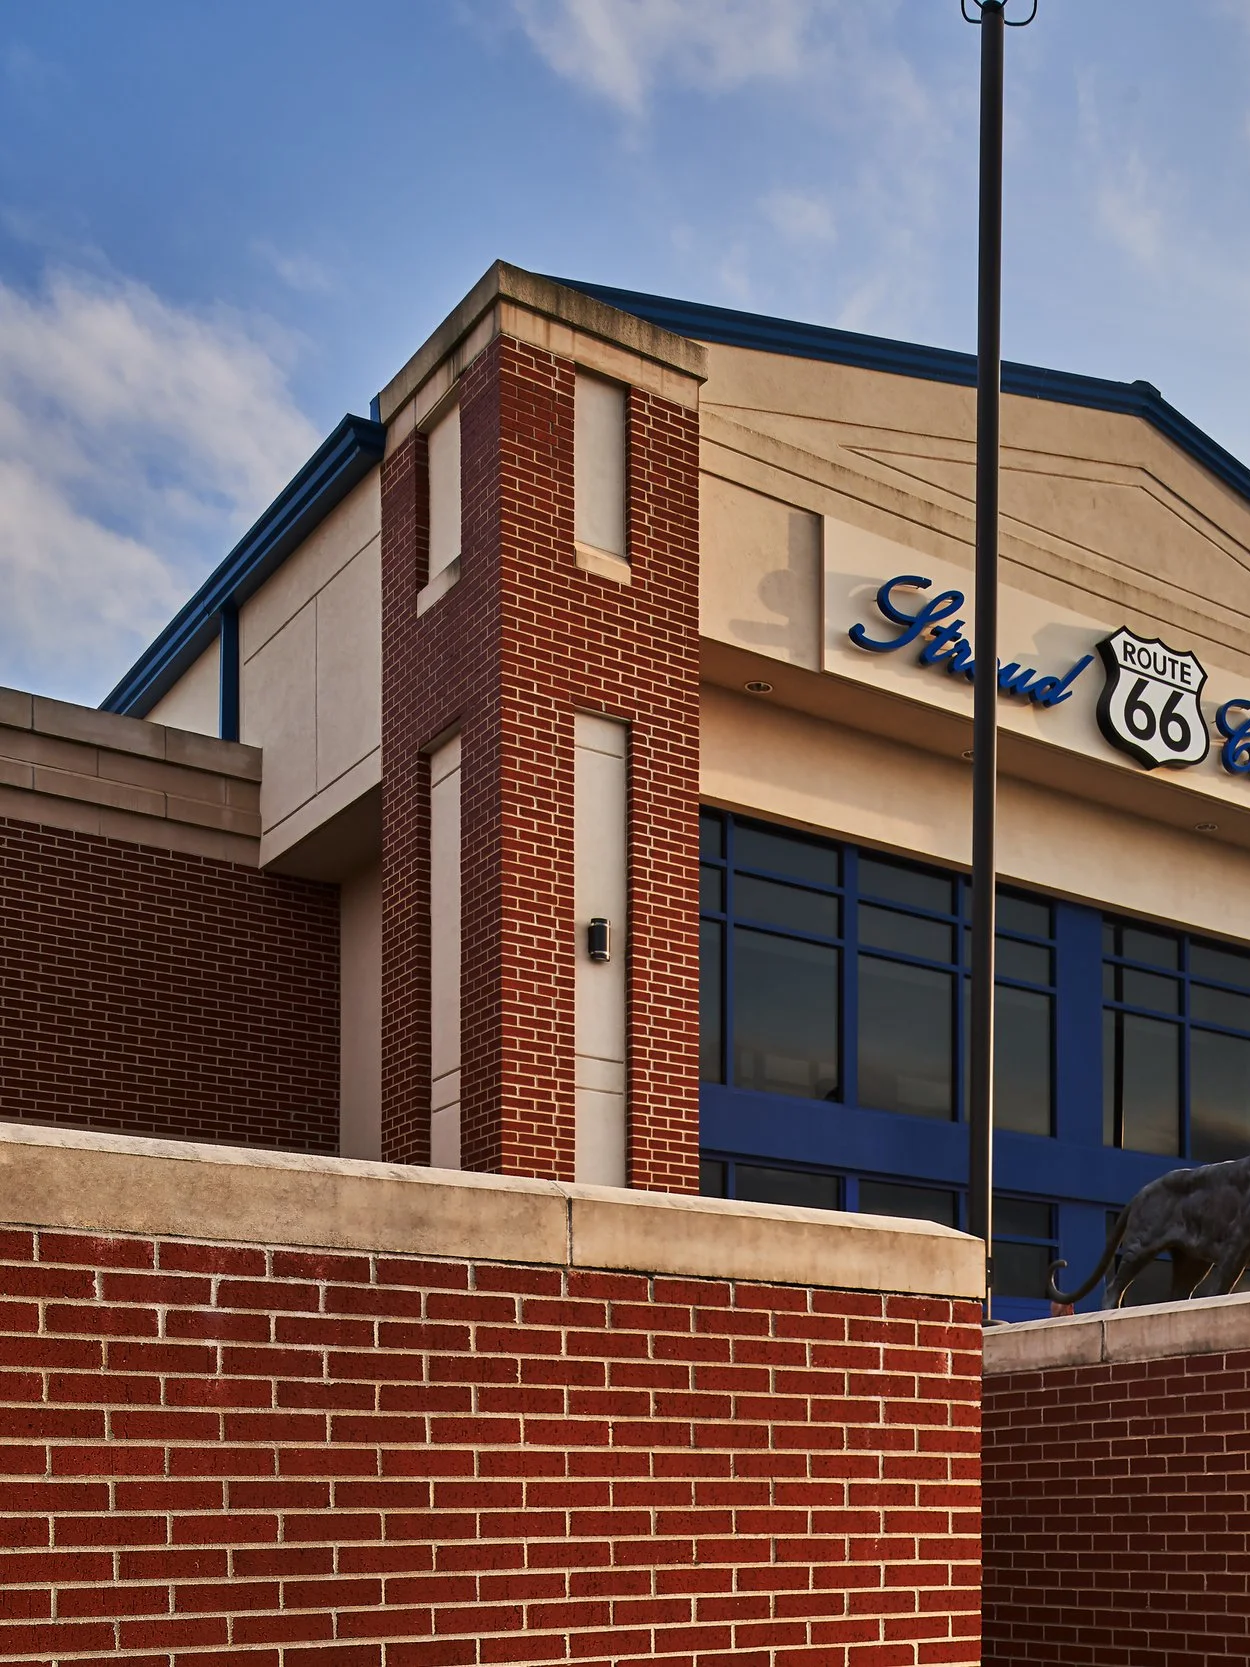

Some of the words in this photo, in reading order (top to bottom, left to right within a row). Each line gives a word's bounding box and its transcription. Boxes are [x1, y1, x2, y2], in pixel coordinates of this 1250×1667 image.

[849, 575, 1095, 708] Strud
[1123, 640, 1192, 685] ROUTE
[1124, 677, 1192, 753] 66
